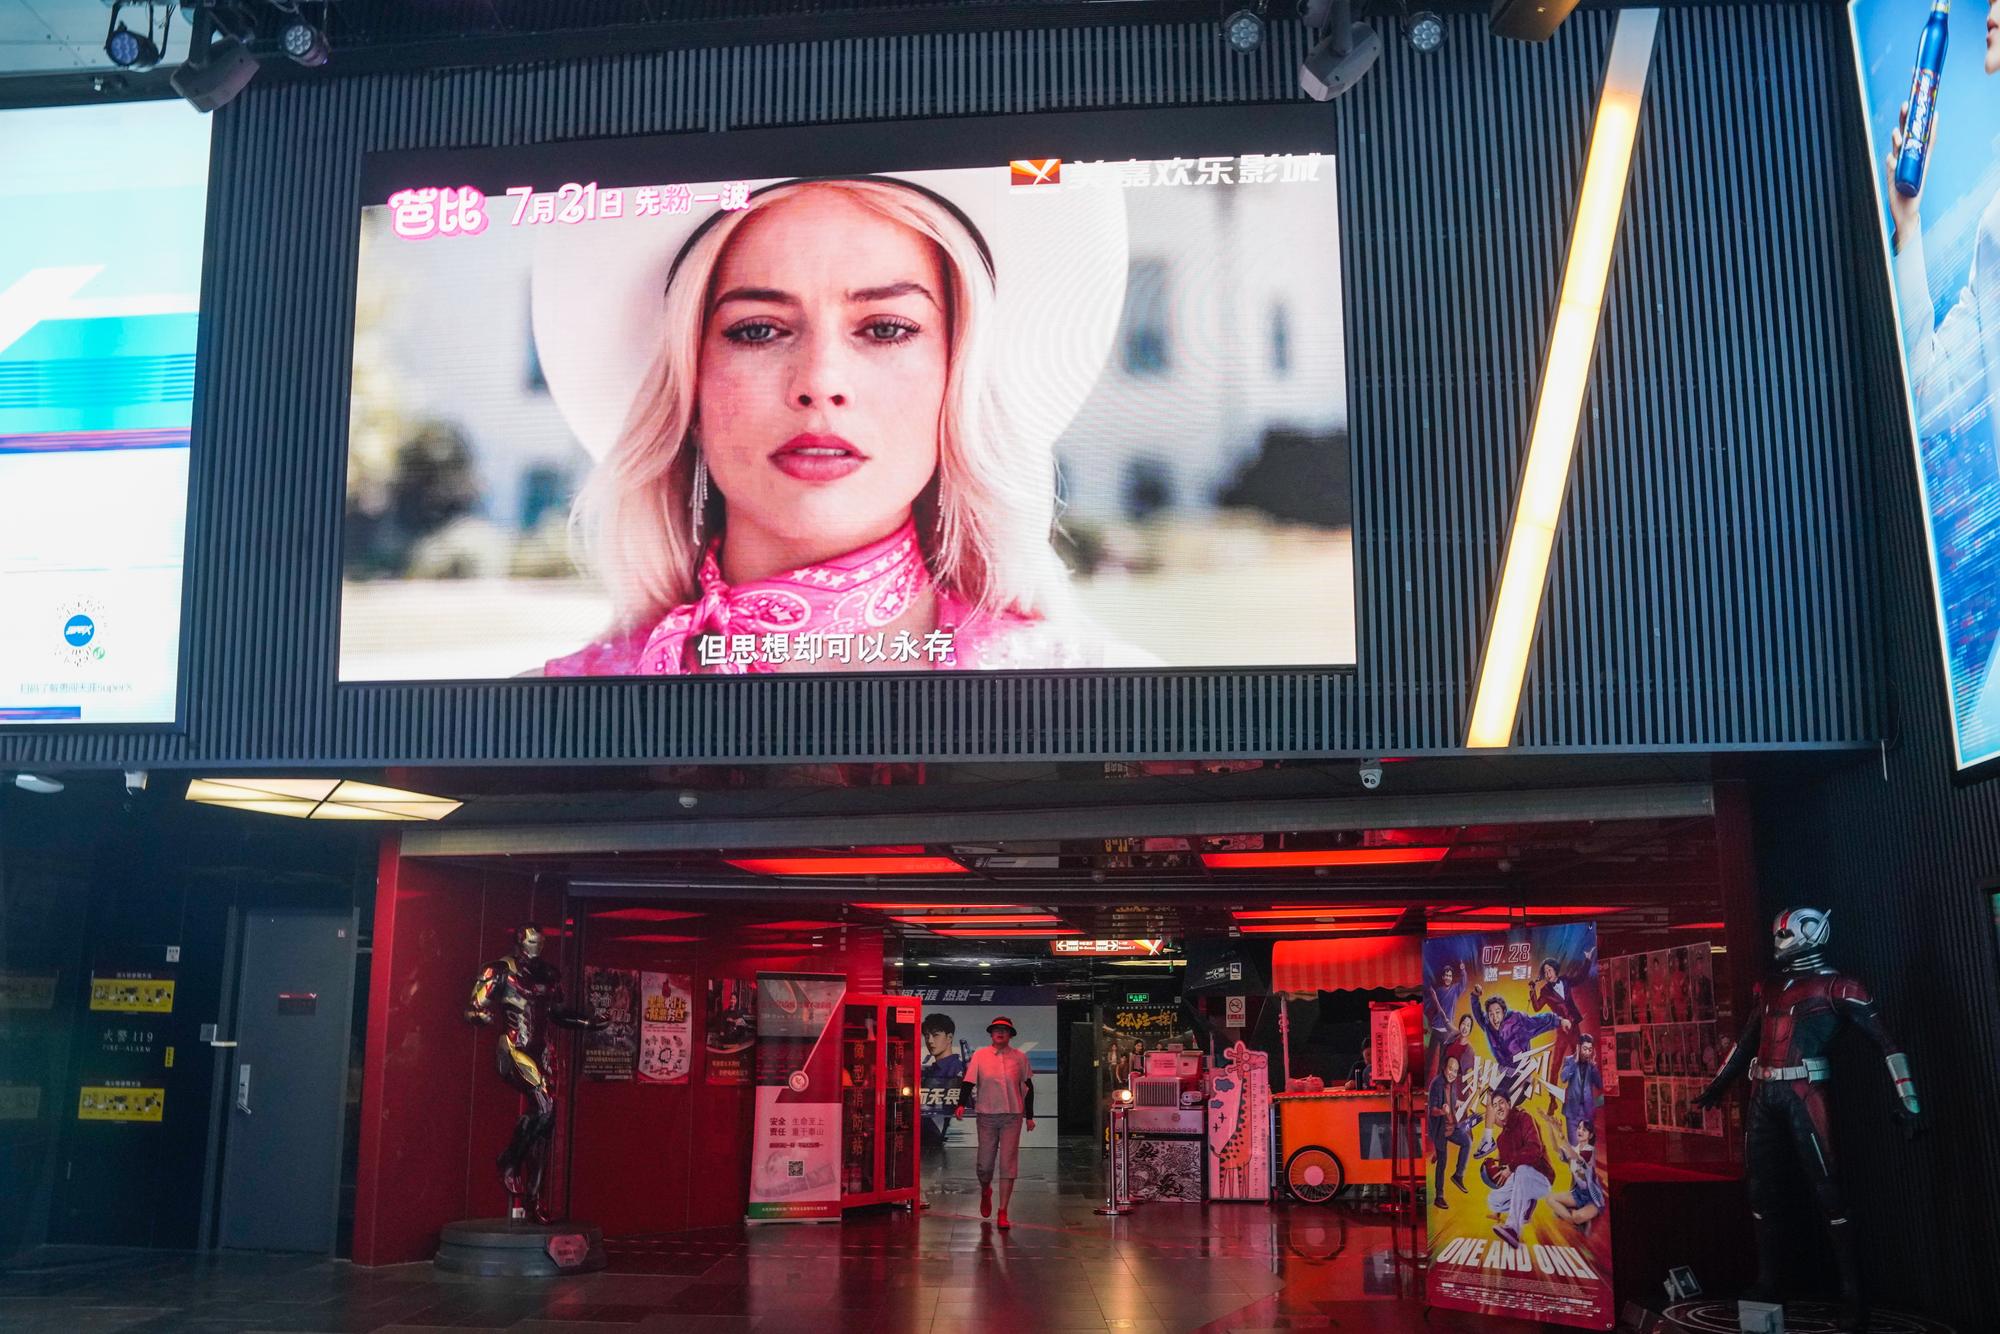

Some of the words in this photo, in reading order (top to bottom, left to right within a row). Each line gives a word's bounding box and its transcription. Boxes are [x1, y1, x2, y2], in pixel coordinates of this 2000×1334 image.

[390, 186, 489, 241] 芭比
[504, 181, 625, 226] 7月21日
[635, 181, 751, 217] 先粉一波
[697, 630, 955, 667] 但思想却可以永存
[1482, 943, 1531, 965] 07.28
[942, 989, 995, 1002] 热烈一夏
[104, 1029, 128, 1043] 火警
[133, 1030, 154, 1043] 119
[1455, 1041, 1566, 1123] 热烈
[769, 1117, 786, 1126] 安全
[769, 1127, 786, 1136] 责任
[1436, 1237, 1486, 1265] ONE
[1482, 1240, 1533, 1273] AND
[1534, 1244, 1600, 1280] ONLY
